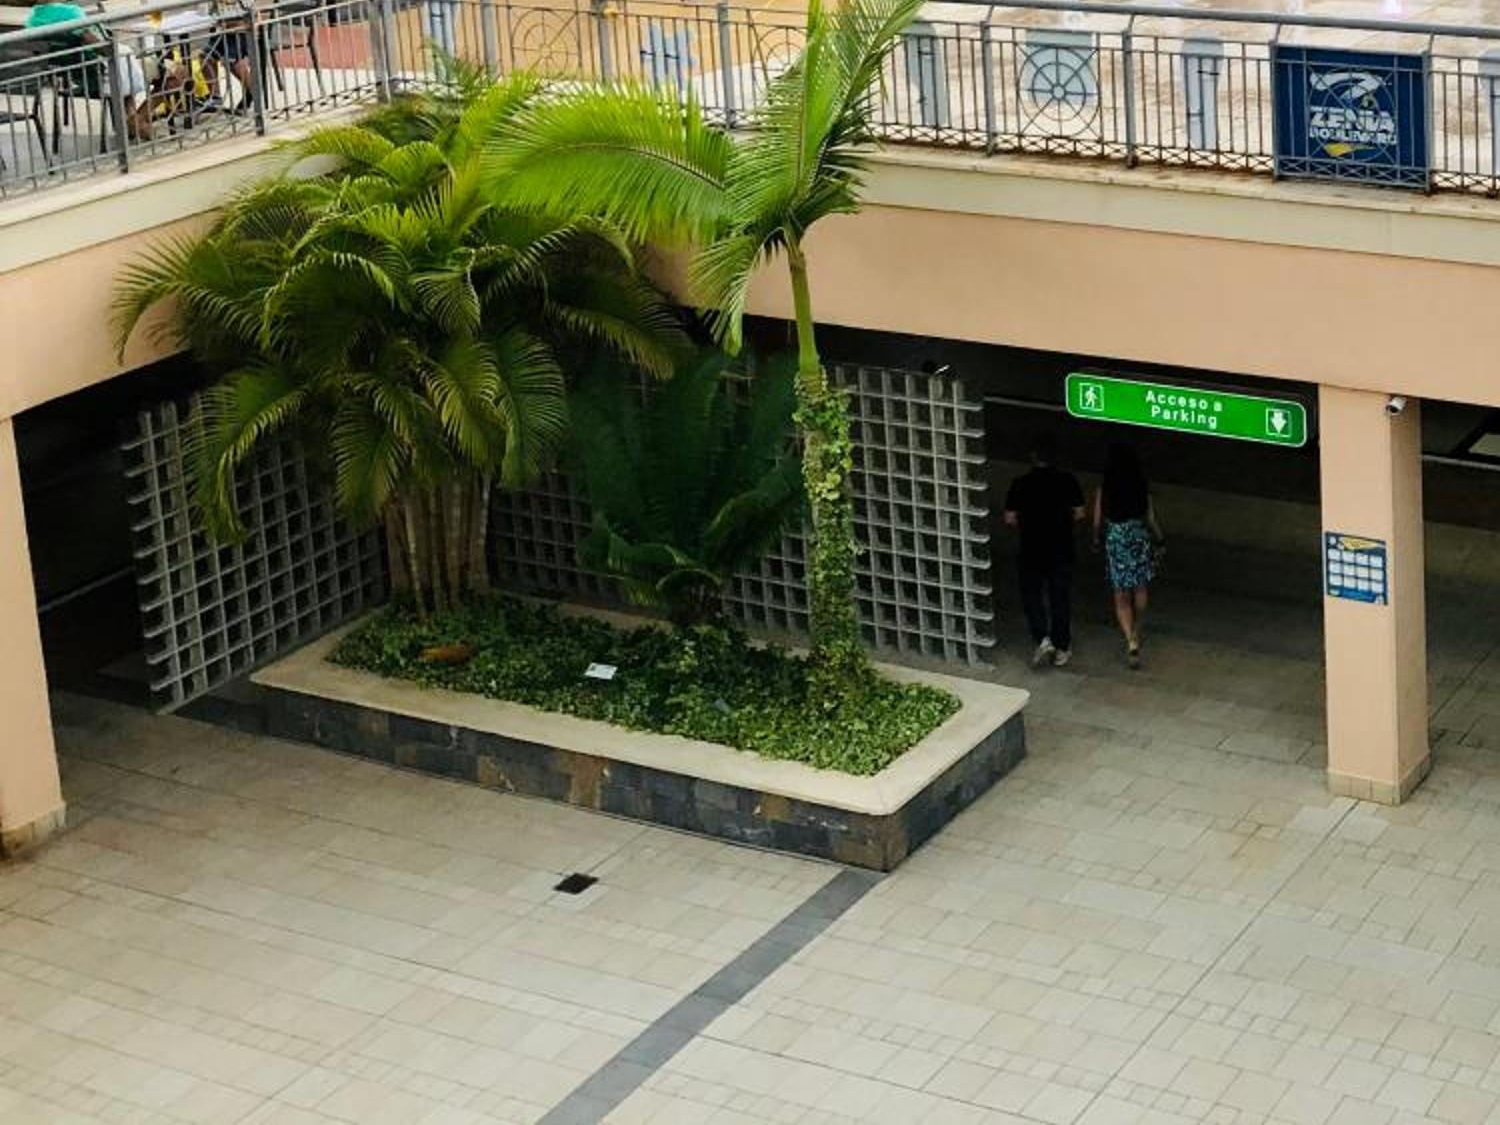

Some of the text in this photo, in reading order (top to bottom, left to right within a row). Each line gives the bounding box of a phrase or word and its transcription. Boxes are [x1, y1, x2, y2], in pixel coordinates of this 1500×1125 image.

[1309, 106, 1396, 133] ZENIA
[1145, 389, 1223, 412] Acceso a
[1151, 405, 1218, 430] Parking
